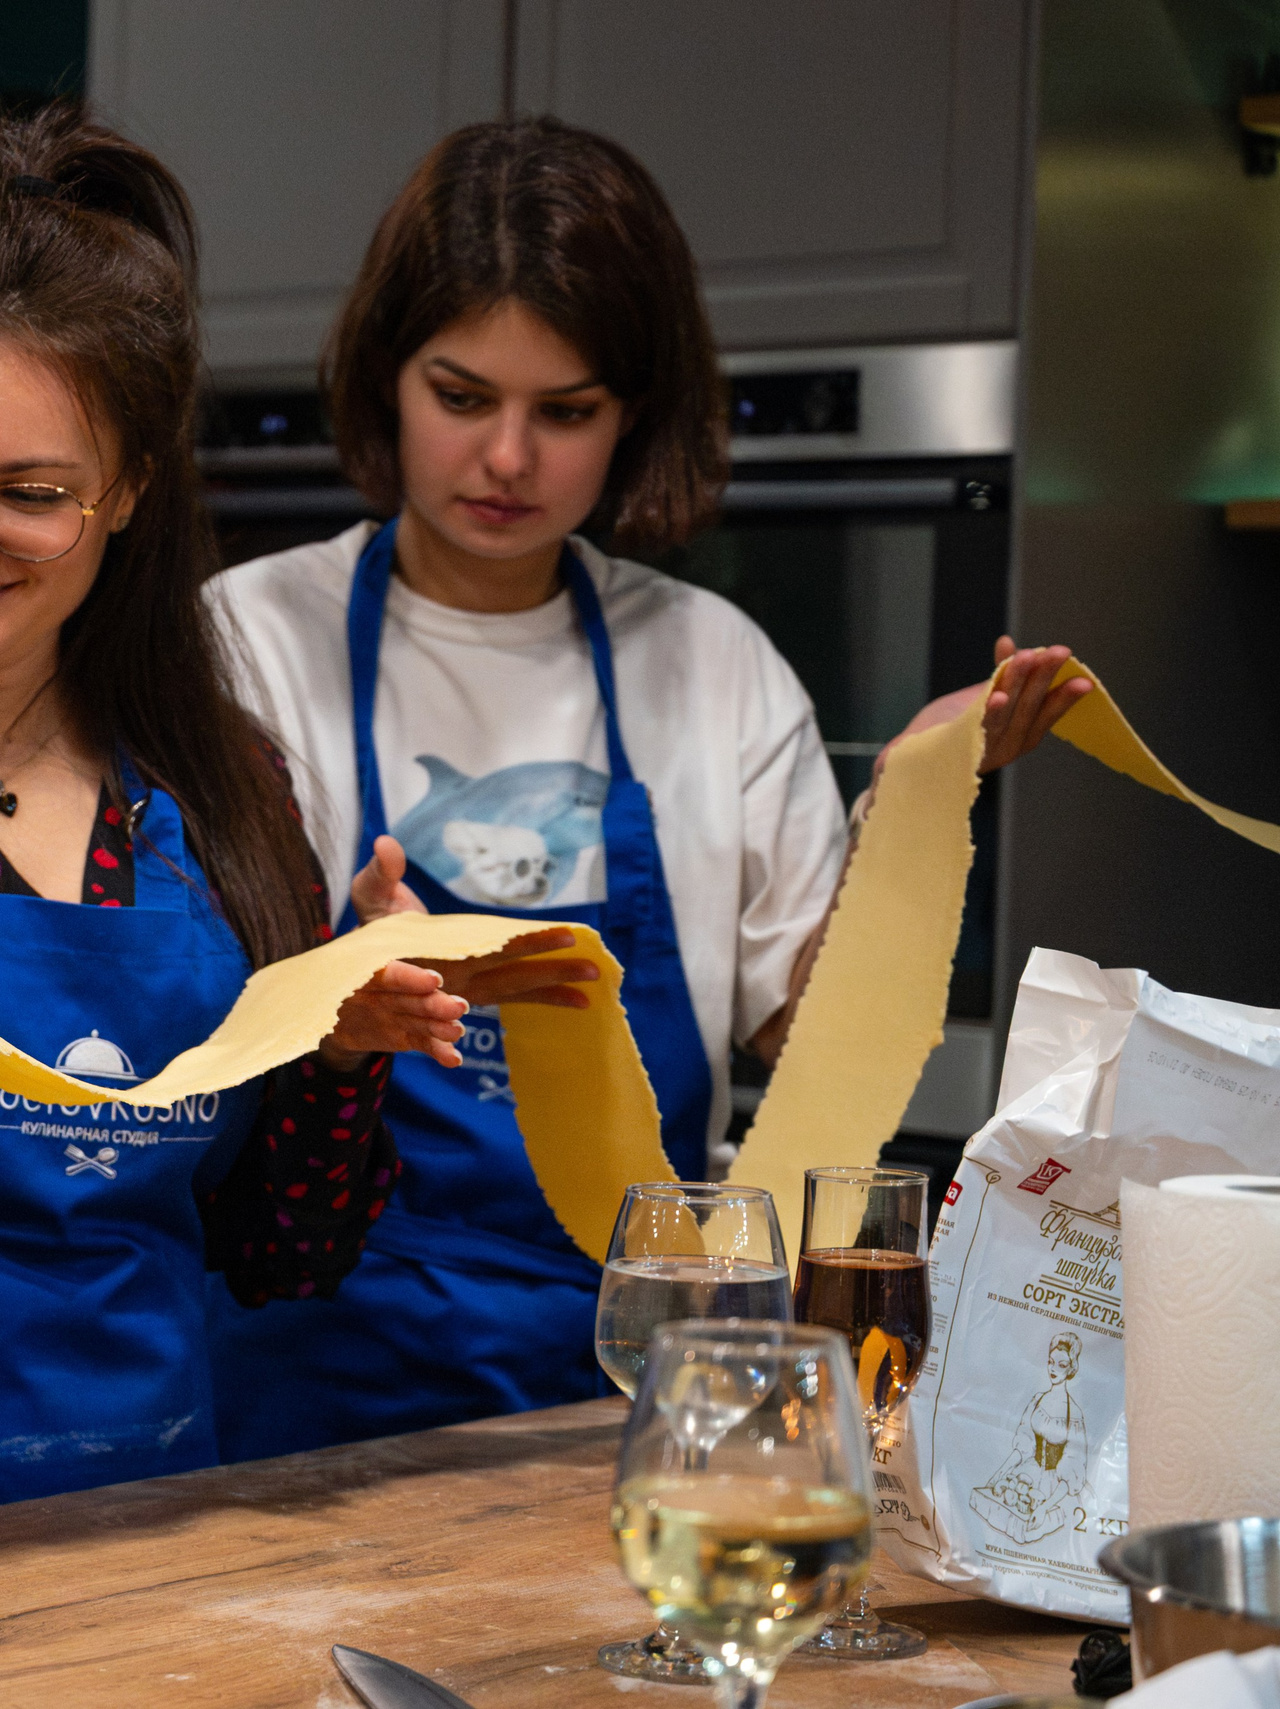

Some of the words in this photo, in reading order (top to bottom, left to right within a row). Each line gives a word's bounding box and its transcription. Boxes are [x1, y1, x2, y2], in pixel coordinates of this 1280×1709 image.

[20, 1120, 110, 1143] КУЛИНАРНАЯ
[111, 1129, 160, 1148] СТУДИЯ
[1053, 1257, 1117, 1292] штучка
[987, 1291, 998, 1301] ИЗ
[998, 1295, 1030, 1311] НЕЖНОЙ
[1030, 1305, 1082, 1327] СЕРДЦЕВИНЫ
[1023, 1283, 1066, 1309] СОРТ
[1069, 1297, 1125, 1329] ЭКСТРА
[1073, 1506, 1087, 1533] 2
[985, 1543, 1002, 1554] МУКА
[1003, 1548, 1046, 1564] ПШЕНИЧНАЯ
